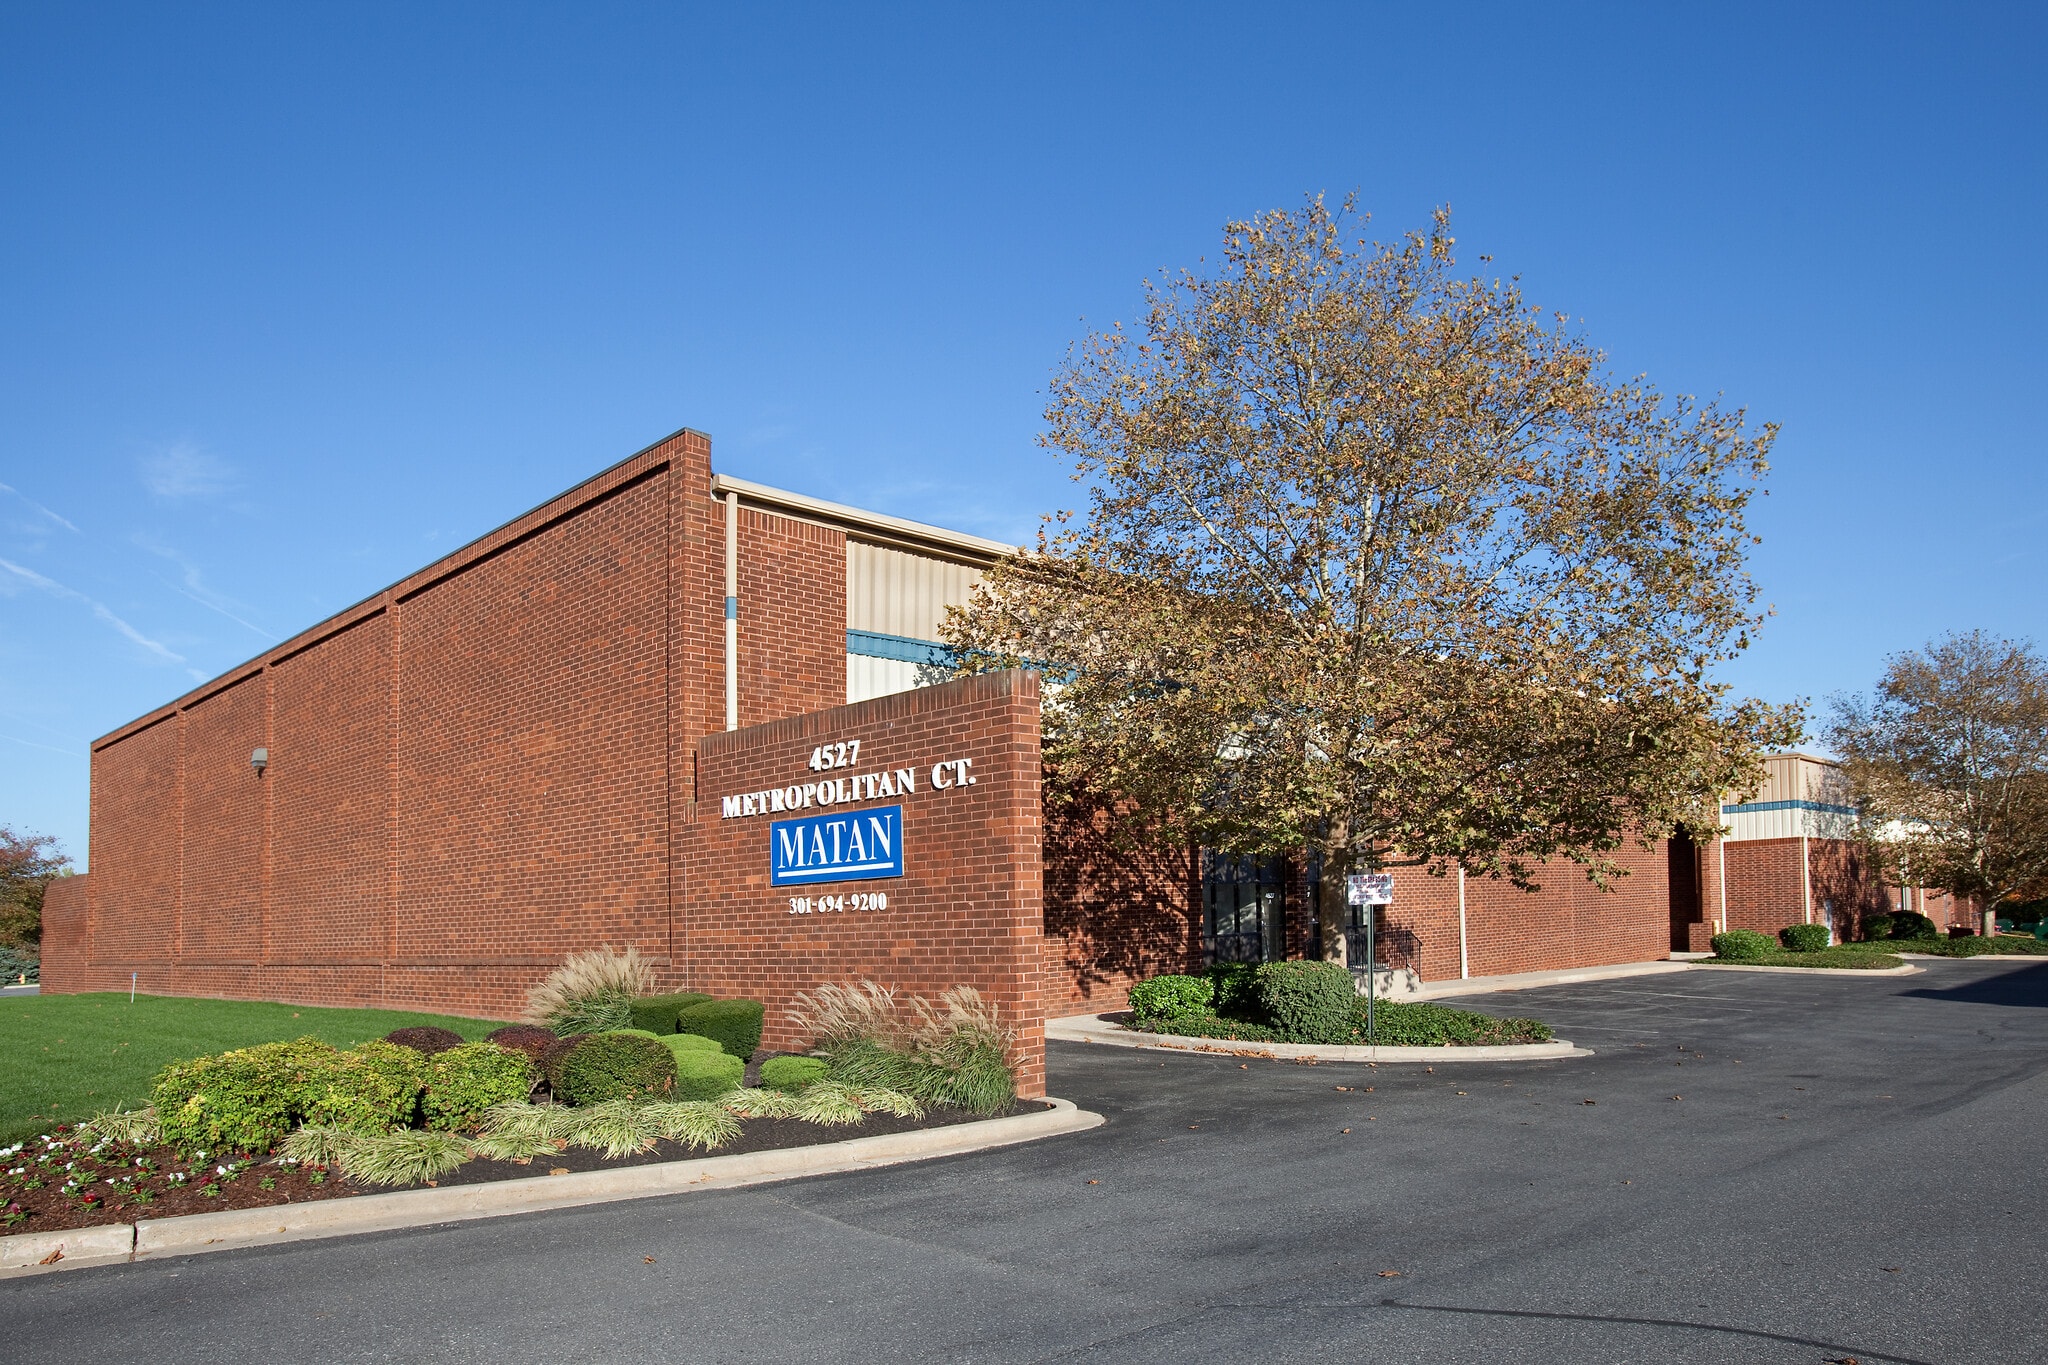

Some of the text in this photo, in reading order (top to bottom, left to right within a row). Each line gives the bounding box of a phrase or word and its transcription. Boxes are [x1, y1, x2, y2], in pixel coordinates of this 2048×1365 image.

[809, 739, 861, 771] 4527
[721, 758, 977, 819] METROPOLITAN CT.
[777, 814, 893, 868] MATAN
[789, 892, 887, 914] 301-694-9200
